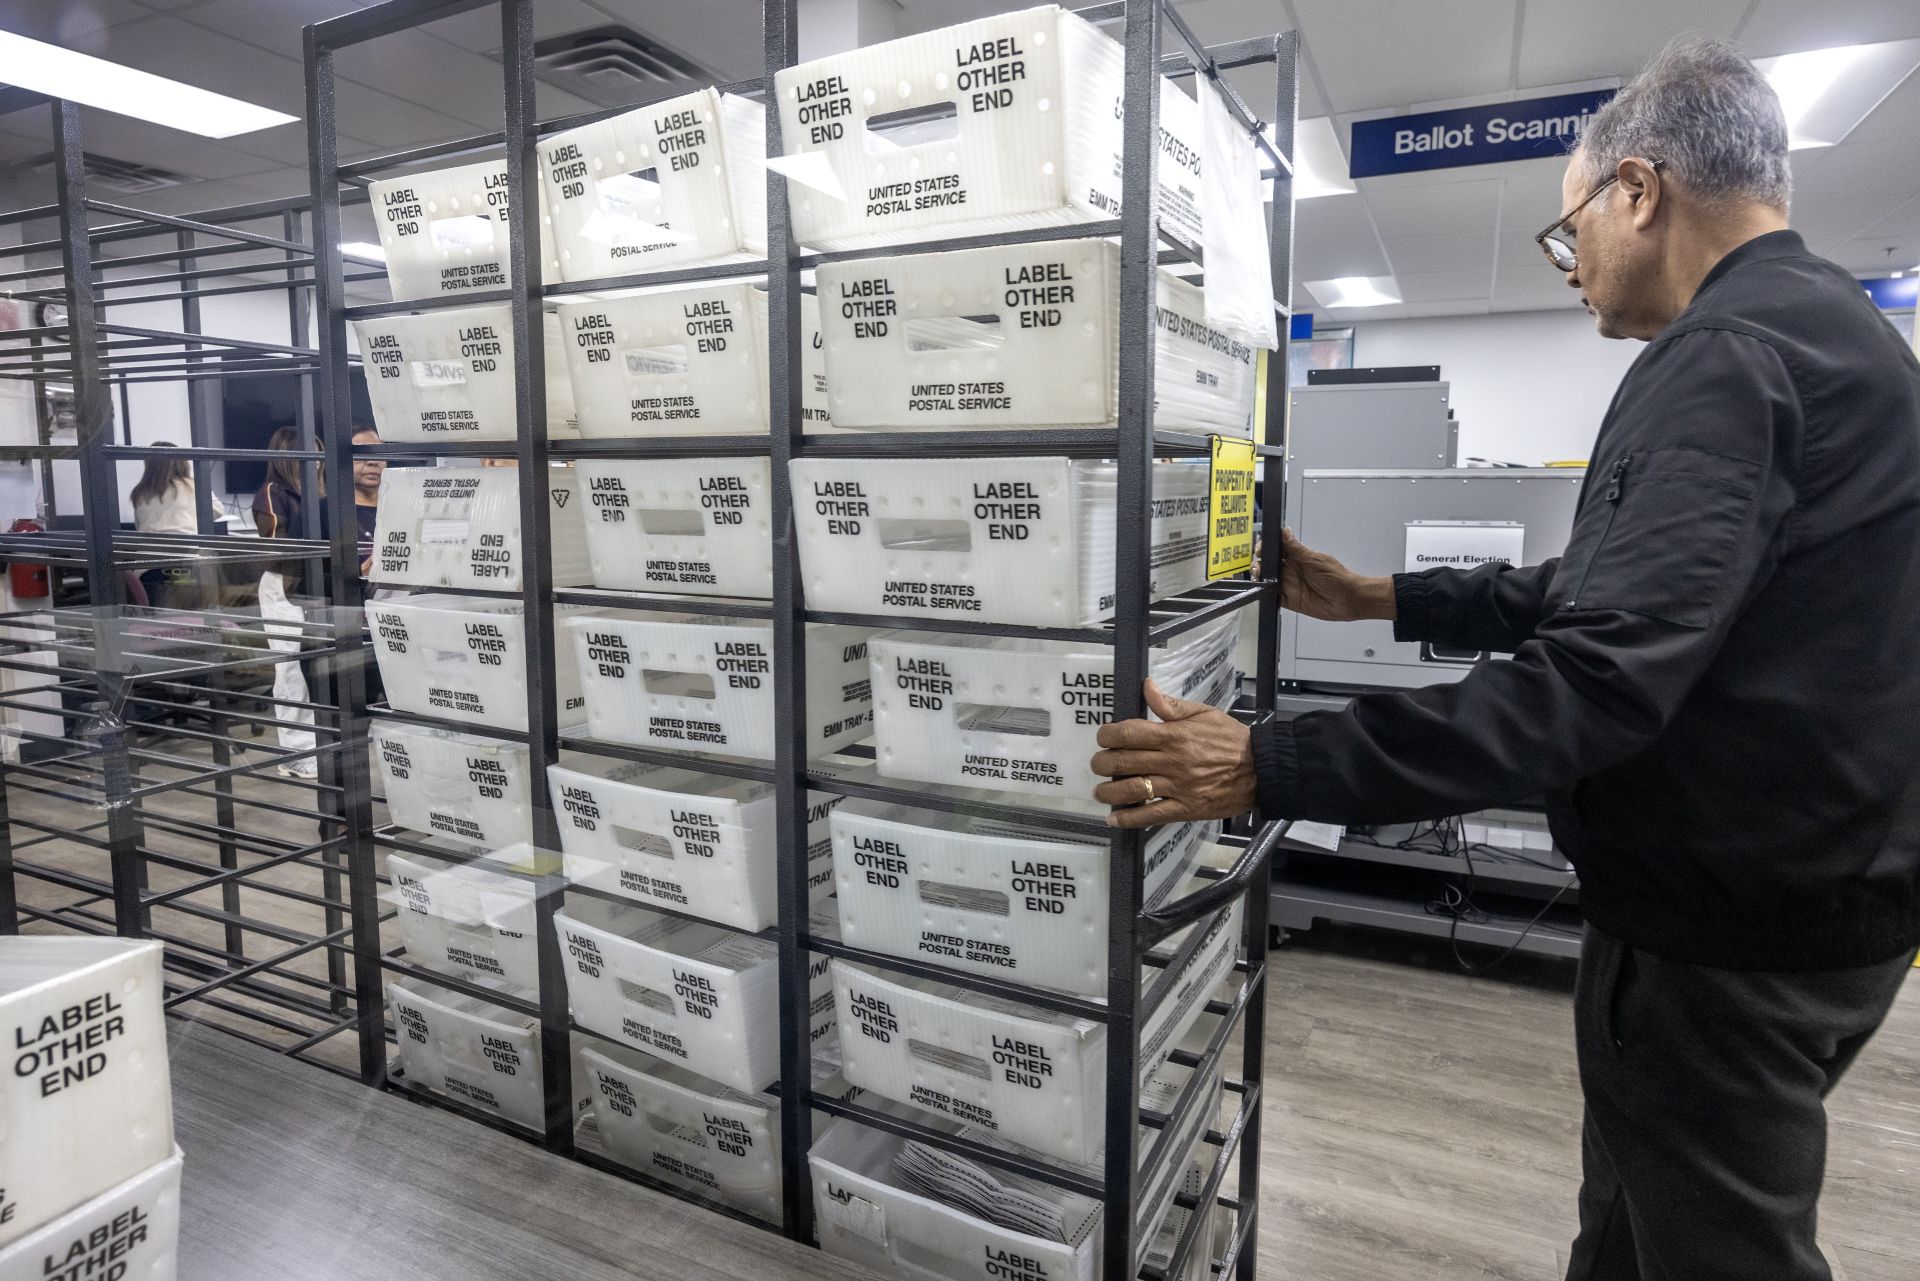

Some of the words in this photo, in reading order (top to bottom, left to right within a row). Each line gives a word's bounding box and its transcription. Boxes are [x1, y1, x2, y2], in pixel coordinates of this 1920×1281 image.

[957, 37, 1023, 68] LABEL
[958, 61, 1025, 92] OTHER
[797, 76, 849, 104] LABEL
[973, 88, 1013, 113] END
[798, 97, 852, 125] OTHER
[655, 110, 702, 135] LABEL
[1394, 123, 1474, 155] Ballot
[1486, 108, 1595, 144] Scanni
[658, 129, 706, 155] OTHER
[811, 123, 843, 144] END
[671, 152, 699, 172] END
[870, 182, 912, 201] UNITED
[915, 174, 960, 195] STATES
[384, 189, 419, 206] LABEL
[867, 196, 912, 217] POSTAL
[915, 190, 966, 210] SERVICE
[388, 205, 423, 221] OTHER
[397, 222, 419, 236] END
[442, 267, 469, 279] UNITED
[470, 263, 500, 275] STATES
[1006, 264, 1073, 285] LABEL
[442, 279, 471, 290] POSTAL
[472, 275, 506, 287] SERVICE
[842, 279, 894, 298] LABEL
[1006, 286, 1074, 307] OTHER
[684, 301, 731, 318] LABEL
[842, 300, 896, 319] OTHER
[1020, 310, 1061, 328] END
[459, 327, 498, 341] LABEL
[687, 319, 733, 336] OTHER
[855, 322, 888, 338] END
[1156, 305, 1179, 333] NITED
[1180, 317, 1208, 347] STATES
[462, 342, 501, 357] OTHER
[698, 338, 726, 353] END
[472, 359, 496, 372] END
[912, 384, 955, 396] UNITED
[958, 382, 1004, 395] STATES
[632, 399, 662, 409] UNITED
[663, 396, 694, 407] STATES
[910, 400, 955, 411] POSTAL
[958, 398, 1011, 410] SERVICE
[632, 411, 663, 421] POSTAL
[665, 409, 700, 419] SERVICE
[700, 477, 747, 491] LABEL
[815, 482, 867, 497] LABEL
[974, 483, 1039, 499] LABEL
[702, 494, 750, 508] OTHER
[816, 501, 869, 517] OTHER
[714, 512, 742, 524] END
[975, 504, 1041, 519] OTHER
[828, 520, 861, 535] END
[989, 524, 1028, 540] END
[480, 535, 504, 547] END
[472, 549, 510, 562] OTHER
[1417, 554, 1460, 563] General
[471, 564, 509, 577] LABEL
[647, 561, 677, 570] UNITED
[678, 562, 710, 572] STATES
[646, 572, 678, 582] POSTAL
[680, 574, 716, 584] SERVICE
[886, 582, 928, 594] UNITED
[930, 584, 974, 597] STATES
[883, 595, 928, 607] POSTAL
[930, 598, 981, 611] SERVICE
[465, 624, 503, 637] LABEL
[468, 638, 506, 652] OTHER
[715, 642, 767, 657] LABEL
[478, 653, 501, 665] END
[717, 658, 769, 673] OTHER
[897, 657, 951, 677] LABEL
[728, 675, 760, 689] END
[898, 674, 953, 695] OTHER
[909, 694, 943, 711] END
[650, 718, 684, 729] UNITED
[686, 721, 721, 733] STATES
[824, 721, 842, 738] EMM
[844, 714, 864, 731] TRAY
[1076, 710, 1114, 725] END
[649, 728, 685, 739] POSTAL
[687, 731, 727, 744] SERVICE
[466, 758, 505, 772] LABEL
[966, 754, 1009, 767] UNITED
[1012, 760, 1057, 773] STATES
[469, 771, 508, 786] OTHER
[962, 766, 1008, 779] POSTAL
[1011, 771, 1063, 785] SERVICE
[479, 786, 503, 799] END
[671, 810, 718, 827] LABEL
[674, 825, 720, 845] OTHER
[685, 842, 714, 858] END
[854, 836, 906, 859] LABEL
[855, 853, 908, 876] OTHER
[1012, 861, 1075, 881] LABEL
[621, 870, 650, 885] UNITED
[651, 879, 682, 894] STATES
[866, 871, 899, 888] END
[1012, 878, 1076, 900] OTHER
[621, 880, 651, 895] POSTAL
[653, 888, 688, 905] SERVICE
[1026, 897, 1064, 914] END
[921, 932, 964, 948] UNITED
[966, 940, 1010, 956] STATES
[919, 942, 963, 958] POSTAL
[966, 949, 1017, 968] SERVICE
[673, 969, 716, 993] LABEL
[675, 984, 718, 1009] OTHER
[850, 989, 896, 1019] LABEL
[686, 1000, 713, 1019] END
[852, 1004, 898, 1034] OTHER
[16, 993, 123, 1050] LABEL
[623, 1018, 652, 1036] UNITED
[653, 1030, 683, 1048] STATES
[862, 1022, 891, 1043] END
[15, 1015, 124, 1079] OTHER
[481, 1035, 517, 1054] LABEL
[623, 1027, 653, 1045] POSTAL
[654, 1039, 688, 1059] SERVICE
[992, 1035, 1051, 1062] LABEL
[484, 1046, 520, 1067] OTHER
[993, 1051, 1052, 1078] OTHER
[40, 1052, 107, 1098] END
[493, 1061, 516, 1076] END
[1006, 1068, 1042, 1089] END
[910, 1093, 950, 1114] POSTAL
[952, 1106, 998, 1132] SERVICE
[911, 1085, 951, 1104] UNITED
[952, 1099, 993, 1121] STATES
[703, 1112, 750, 1134] LABEL
[706, 1125, 753, 1148] OTHER
[718, 1139, 746, 1157] END
[44, 1206, 147, 1277] LABEL
[47, 1223, 147, 1281] THER
[986, 1245, 1048, 1277] LABEL
[986, 1261, 1048, 1281] OTHER
